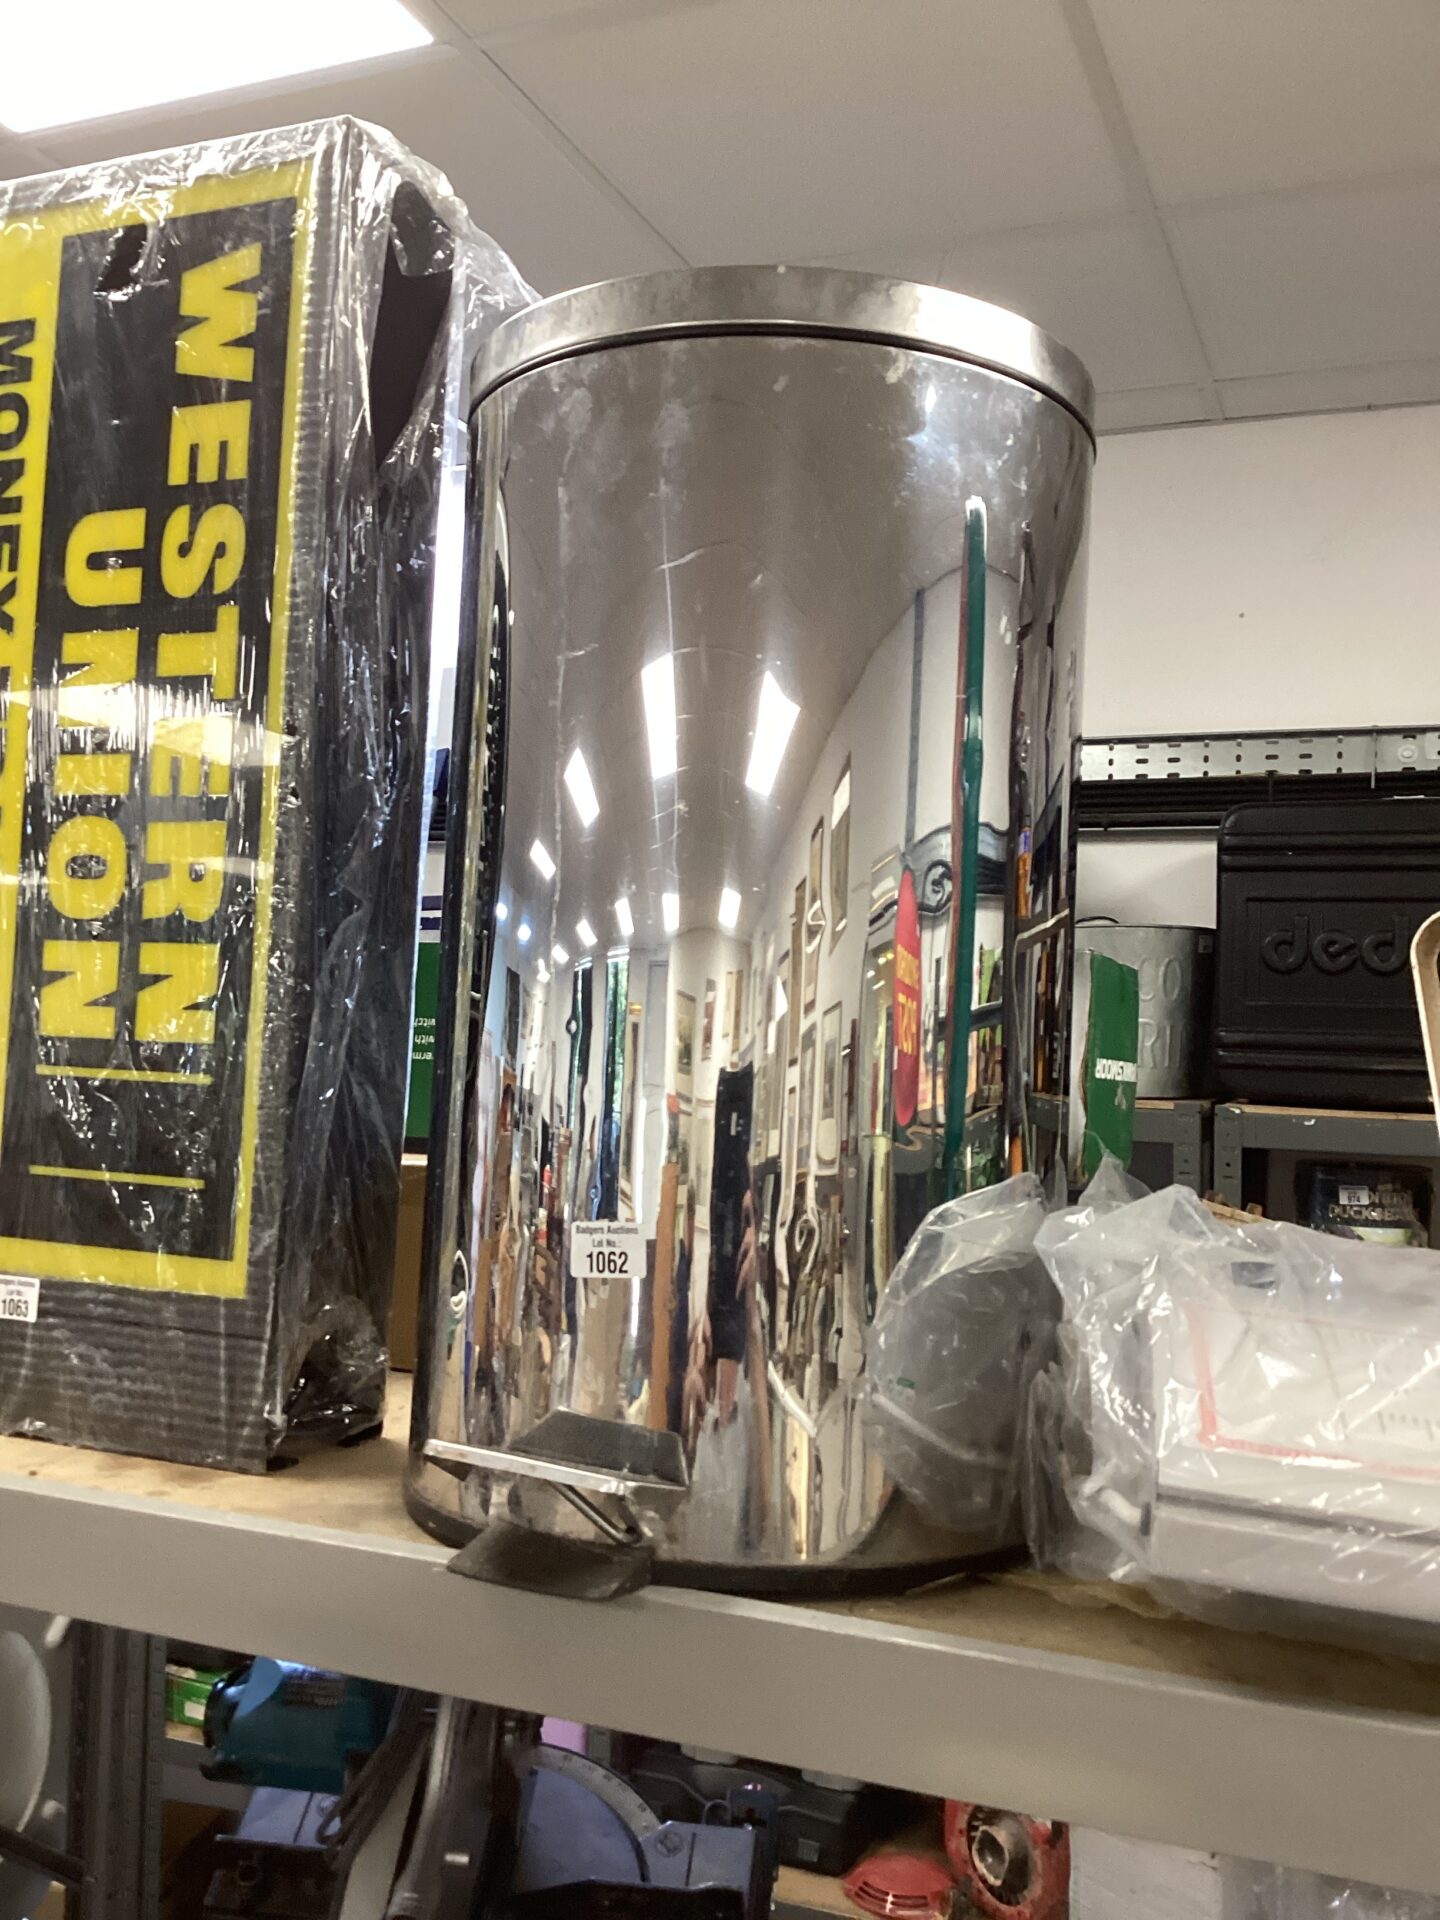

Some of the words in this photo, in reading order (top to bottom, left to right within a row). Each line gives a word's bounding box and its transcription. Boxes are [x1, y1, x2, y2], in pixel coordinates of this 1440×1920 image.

[39, 508, 147, 1039] UNION
[135, 243, 262, 1043] WESTERN
[2, 1298, 29, 1318] 1063
[586, 1250, 628, 1274] 1062
